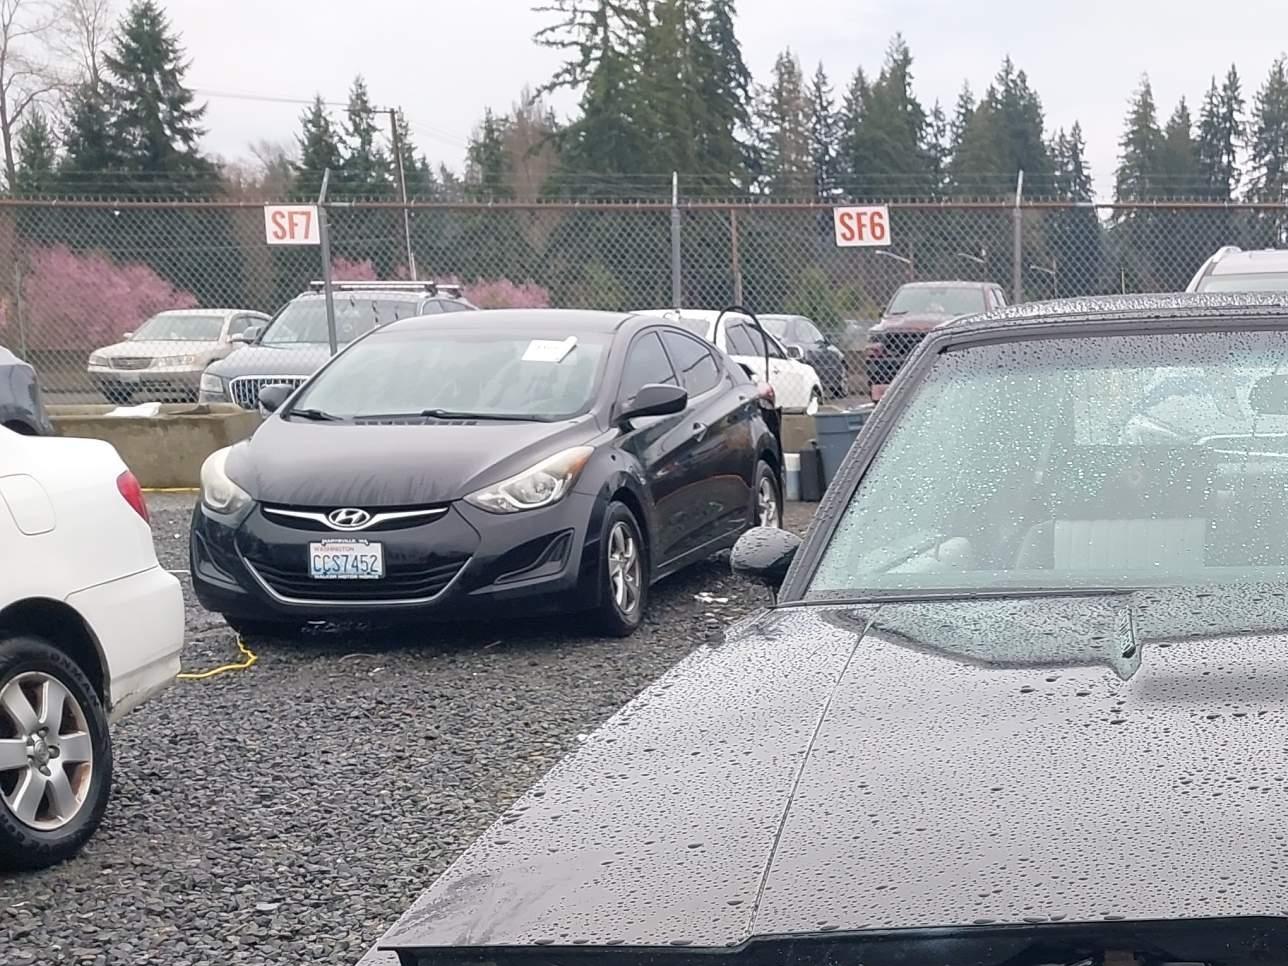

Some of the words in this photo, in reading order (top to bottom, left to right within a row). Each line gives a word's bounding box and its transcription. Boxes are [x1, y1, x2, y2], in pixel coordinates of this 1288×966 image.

[272, 211, 313, 240] SF7
[839, 211, 886, 242] SF6
[313, 554, 379, 573] CCS7452
